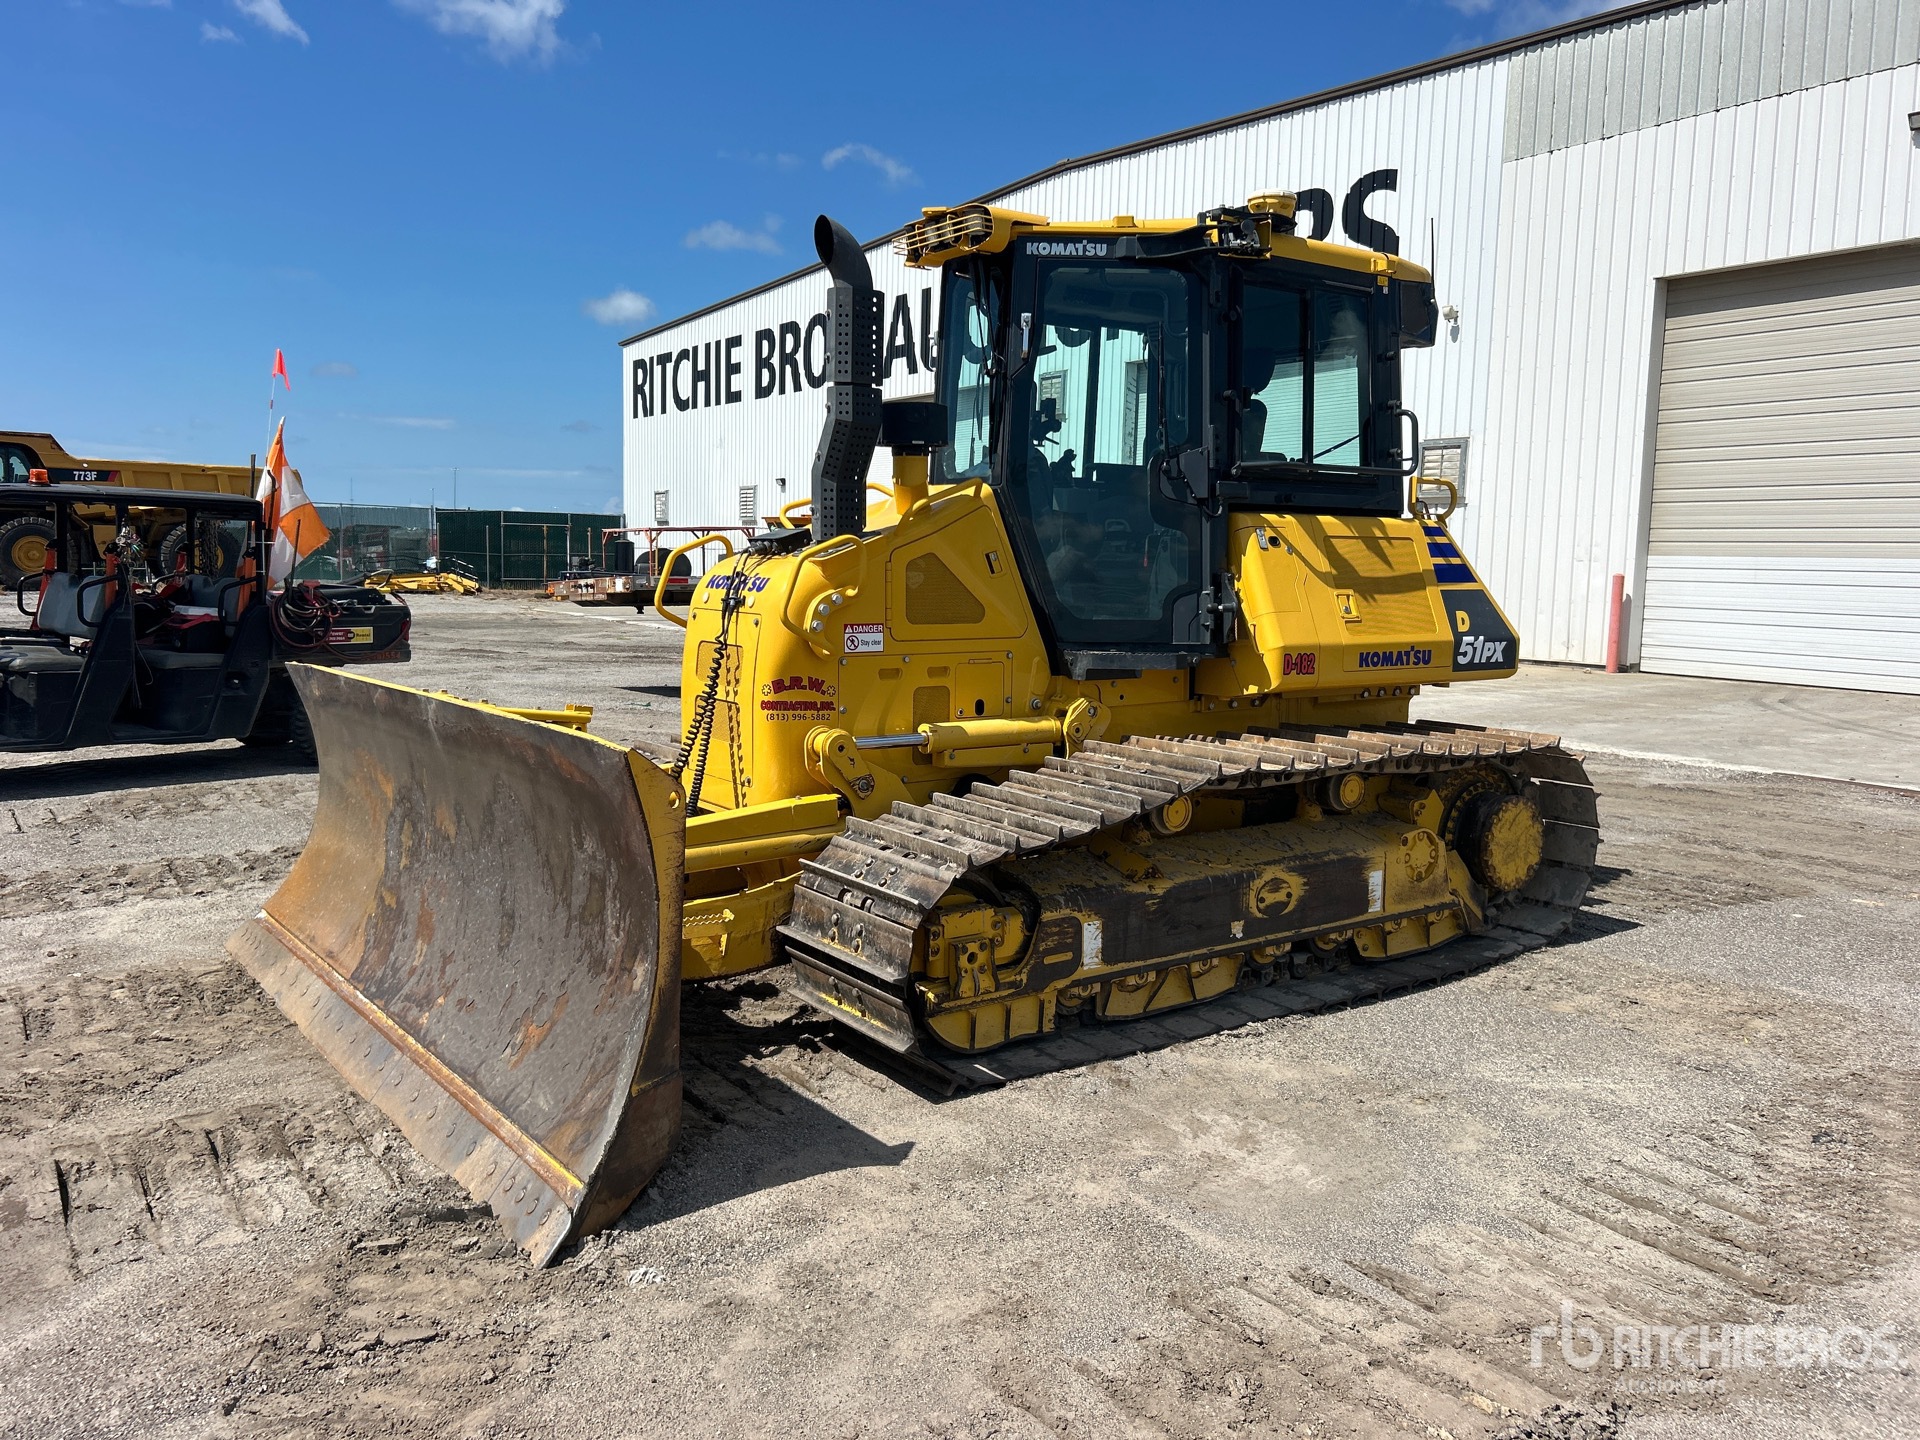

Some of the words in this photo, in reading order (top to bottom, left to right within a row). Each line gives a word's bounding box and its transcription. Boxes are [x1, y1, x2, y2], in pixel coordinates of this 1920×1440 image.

[1026, 240, 1107, 257] KOMATSU
[632, 334, 743, 420] RITCHIE
[754, 312, 828, 400] BRO
[73, 471, 98, 481] 773F
[705, 572, 771, 593] KOTSU
[853, 624, 883, 633] DANGER
[1455, 610, 1471, 633] D
[860, 639, 870, 648] Stay
[1456, 636, 1508, 665] 51PX
[1283, 652, 1316, 676] D-182
[1358, 645, 1433, 668] KOMATSU
[771, 675, 828, 696] B.R.W.
[766, 713, 789, 722] (813)
[791, 712, 832, 721] 996-5882
